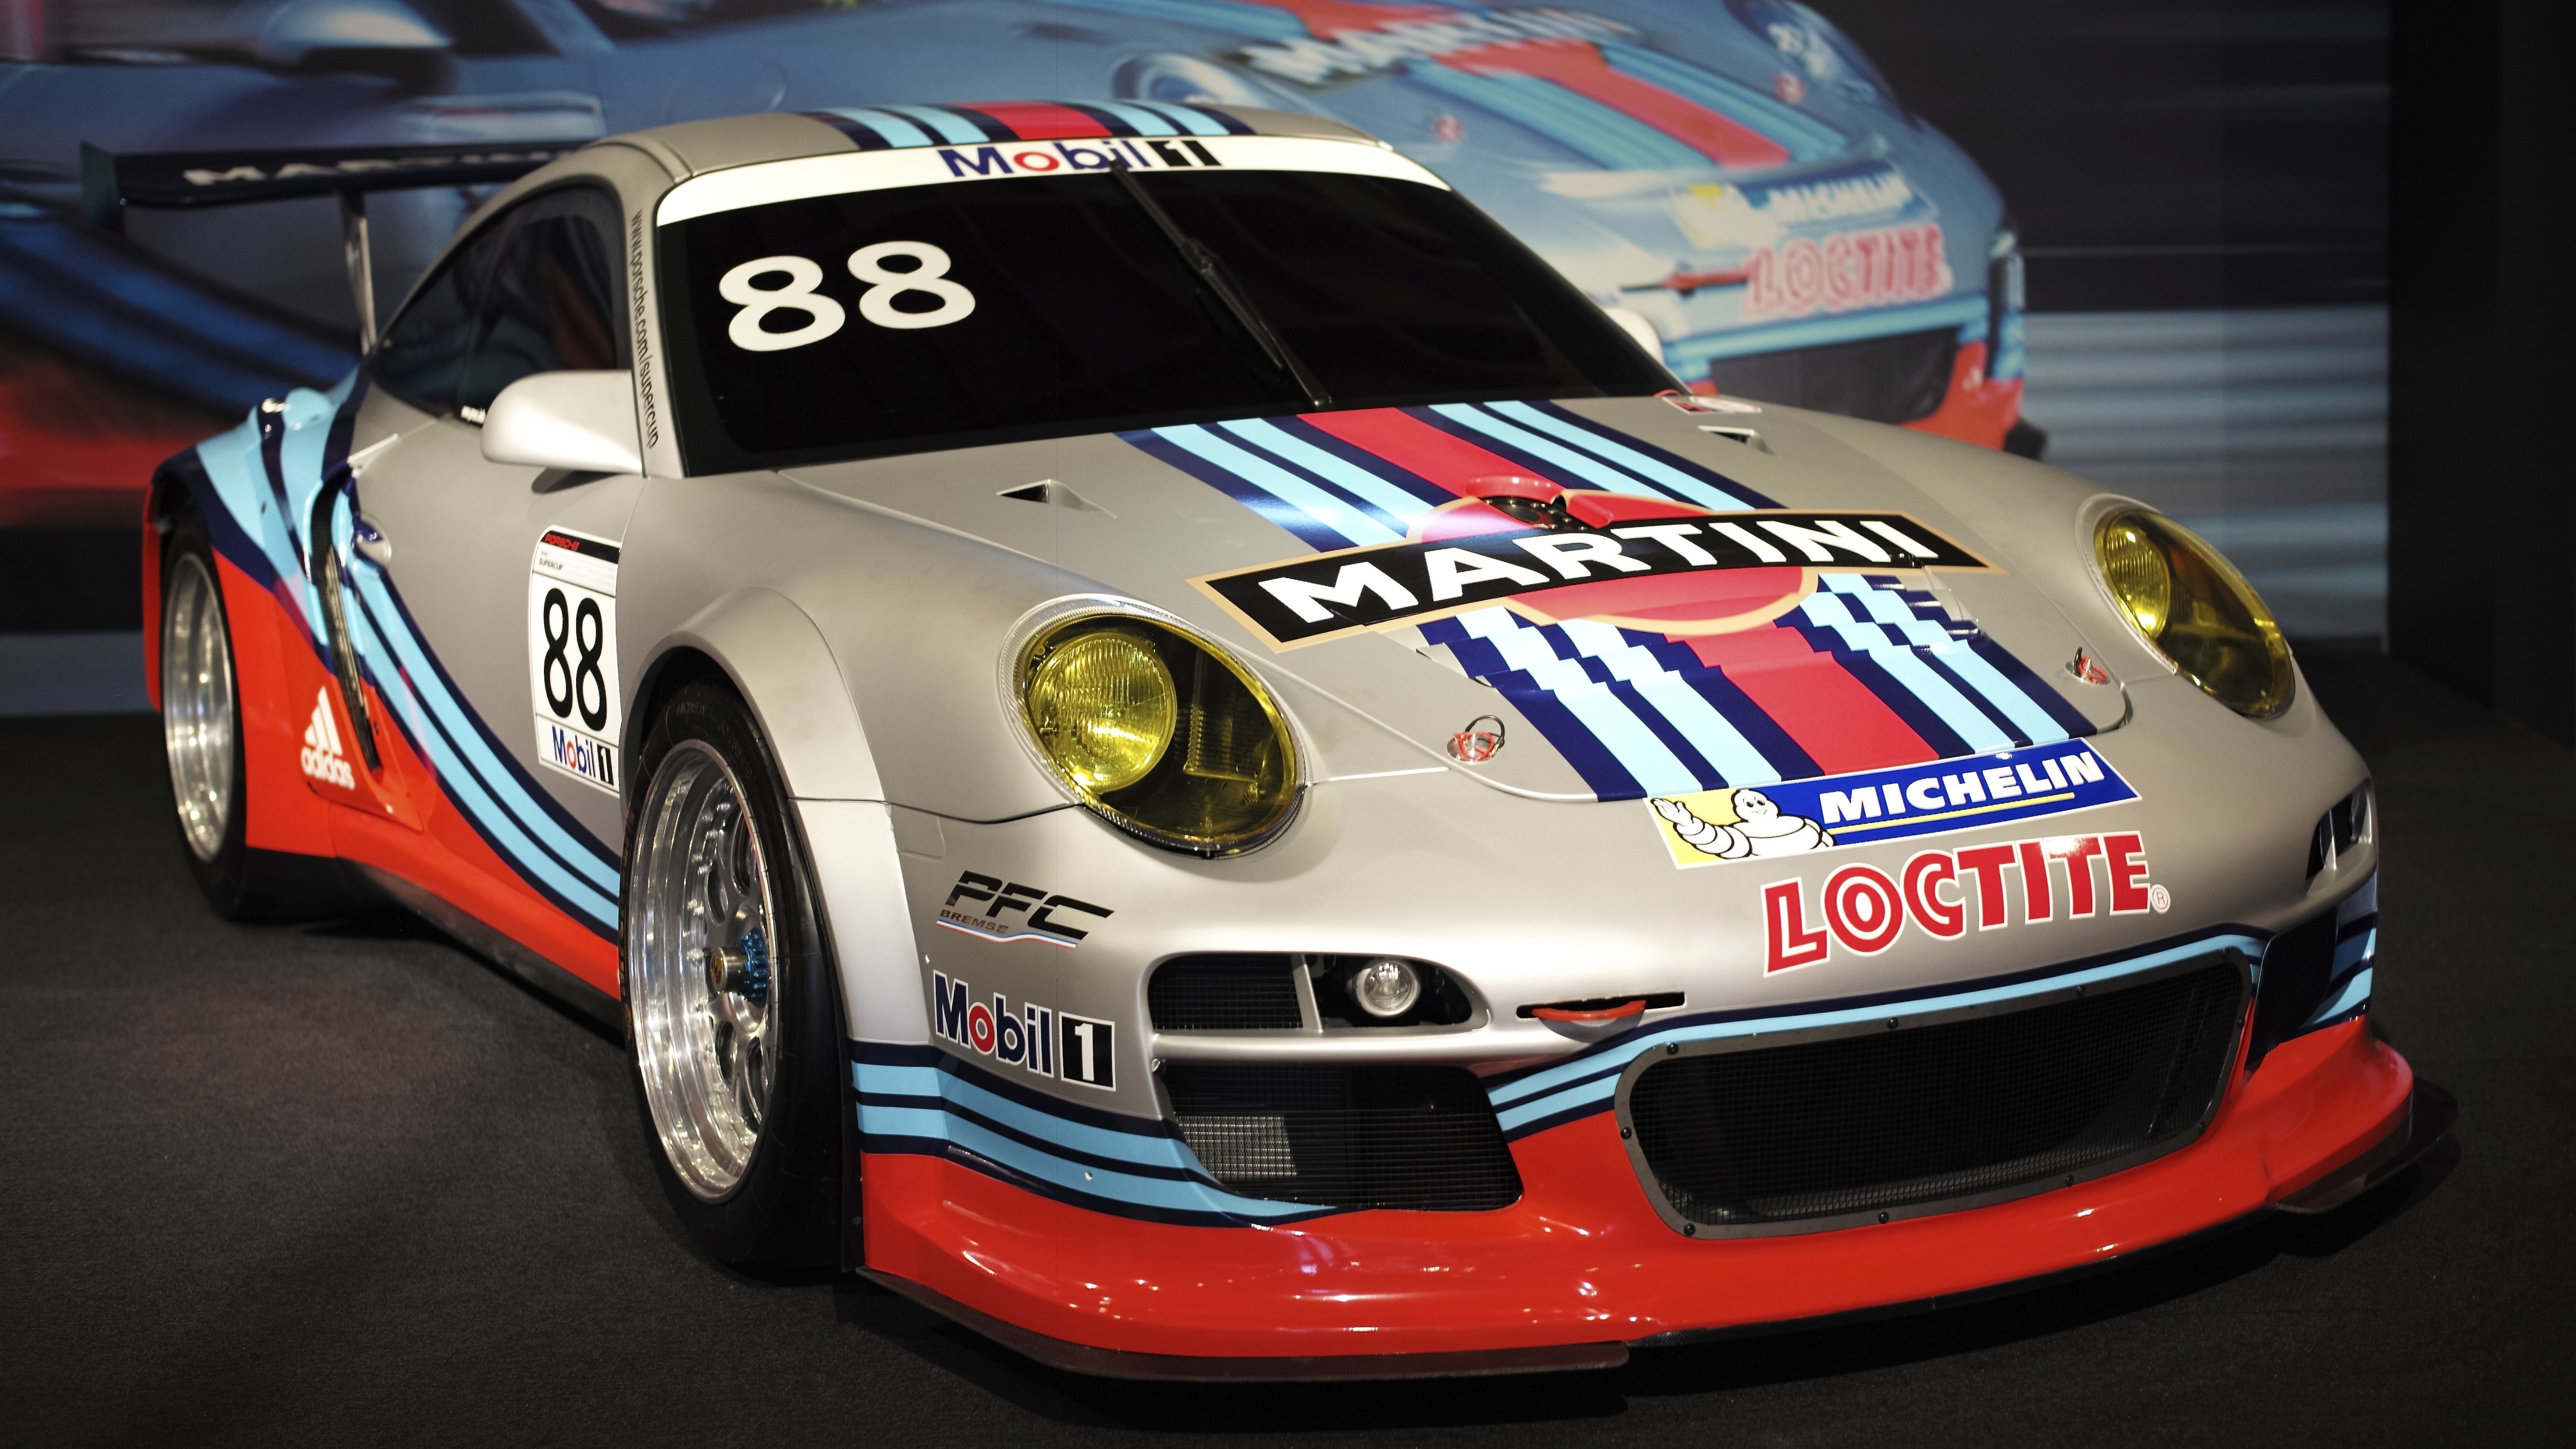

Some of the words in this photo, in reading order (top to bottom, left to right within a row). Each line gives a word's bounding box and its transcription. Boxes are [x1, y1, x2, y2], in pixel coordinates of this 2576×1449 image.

[937, 139, 1152, 177] Mobil
[719, 240, 976, 351] 88
[1742, 223, 1947, 318] LOCTITE
[630, 208, 659, 449] www.porsche.com/supercup
[1259, 519, 1940, 624] MARTINI
[543, 588, 607, 732] 88
[300, 744, 356, 791] adidas
[552, 726, 596, 778] Mobil
[1819, 751, 2105, 824] MICHELIN
[940, 909, 1009, 934] BREMSE
[945, 870, 1116, 940] PFC
[933, 970, 1054, 1078] Mobil
